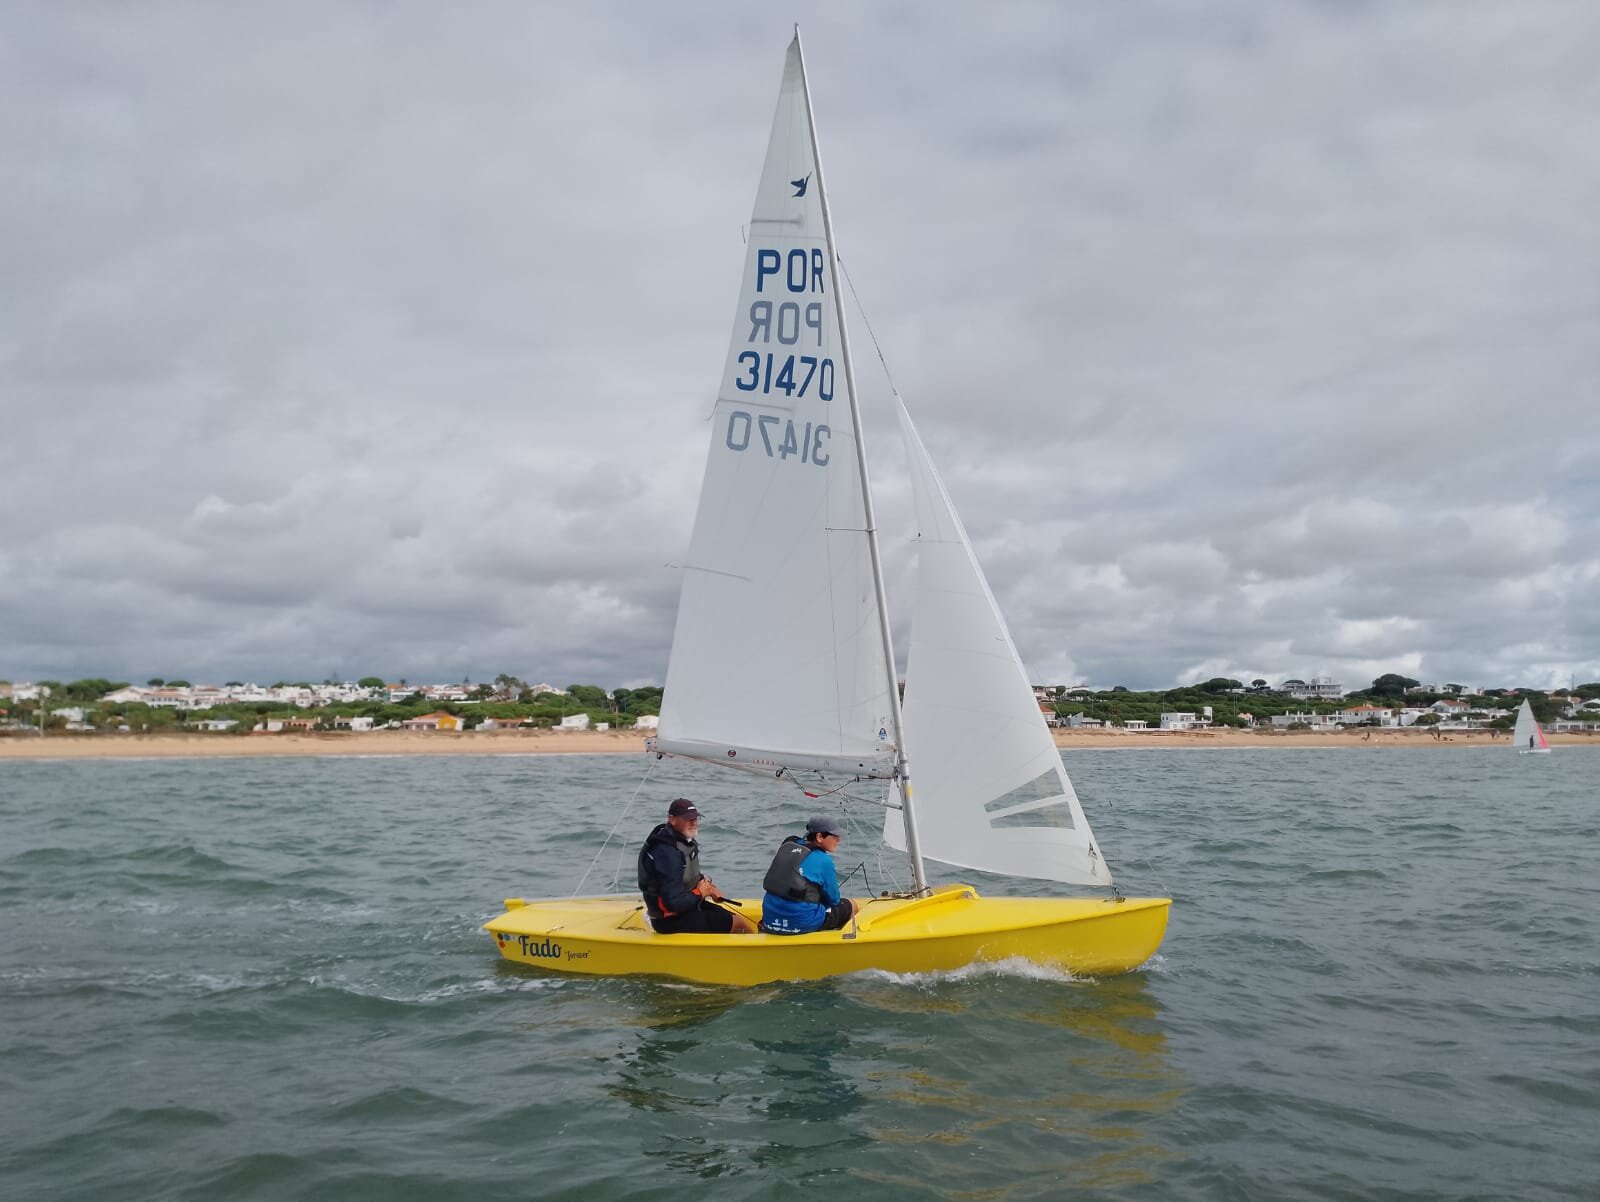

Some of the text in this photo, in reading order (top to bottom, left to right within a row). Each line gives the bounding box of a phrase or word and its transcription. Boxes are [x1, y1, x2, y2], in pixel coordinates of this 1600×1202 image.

[756, 248, 825, 294] POR
[735, 350, 835, 402] 31470
[518, 935, 562, 958] Fado
